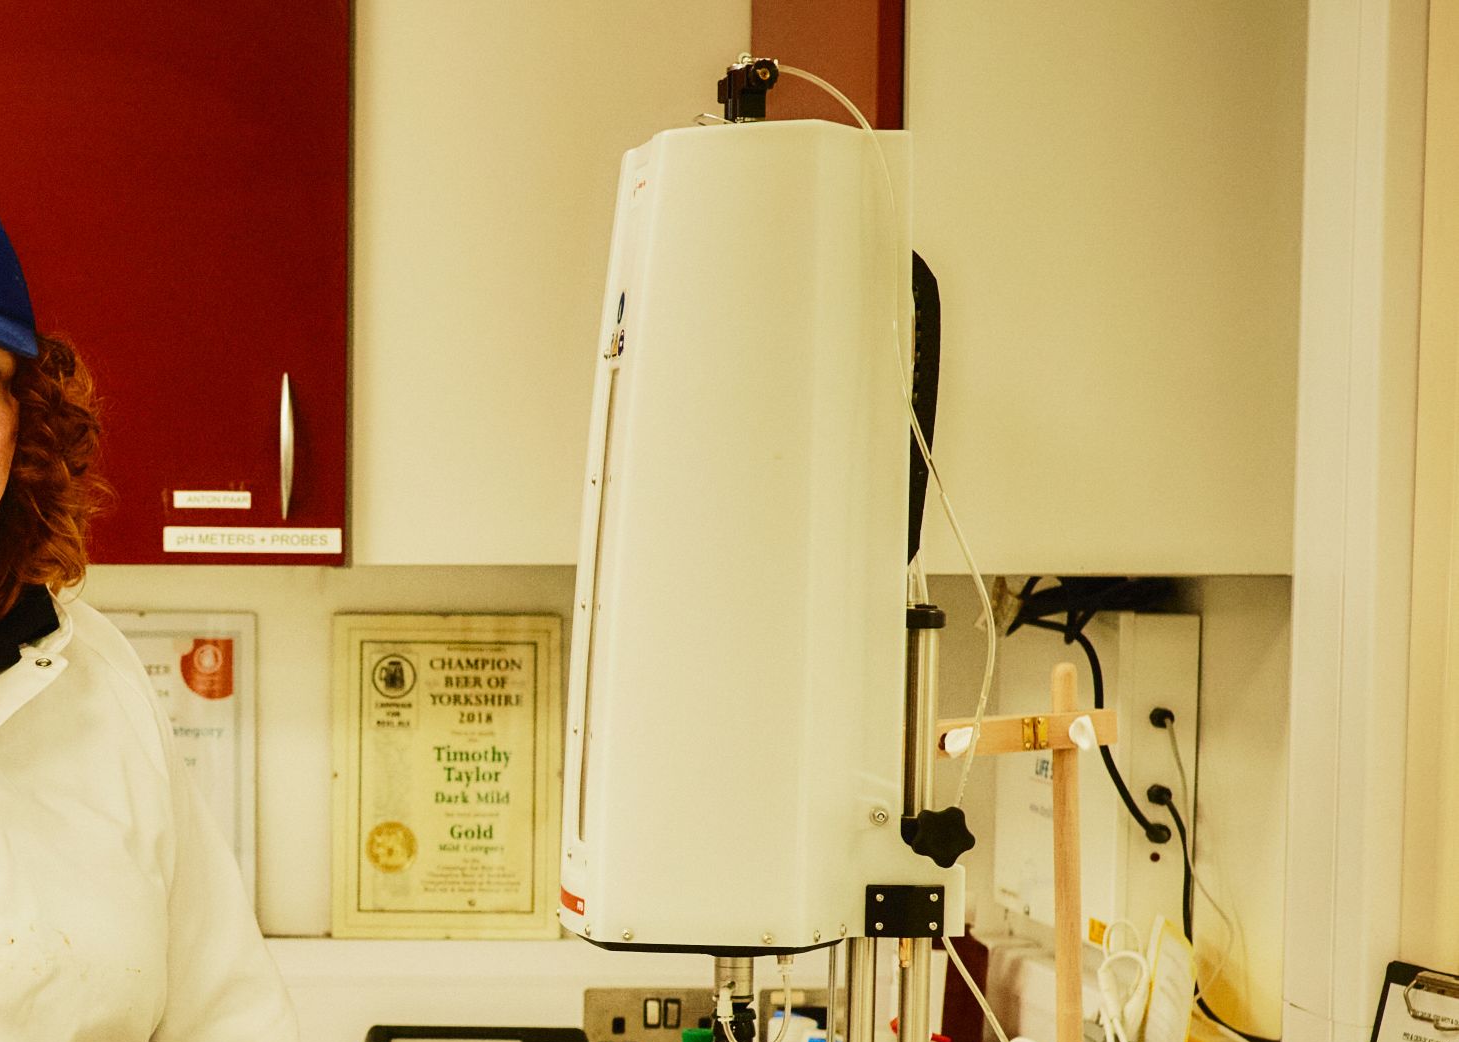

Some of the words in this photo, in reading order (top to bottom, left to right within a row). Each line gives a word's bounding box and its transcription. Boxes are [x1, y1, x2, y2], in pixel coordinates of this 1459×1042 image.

[186, 494, 221, 504] ANTON
[176, 534, 194, 547] pH
[198, 534, 256, 546] METERS
[271, 534, 329, 547] PROBES
[429, 657, 523, 671] CHAMPION
[444, 675, 483, 688] BEER
[486, 676, 509, 689] OF
[430, 693, 524, 707] YORKSHIRE
[458, 711, 494, 724] 2018
[433, 745, 512, 768] Timothy
[444, 766, 502, 788] Taylor
[434, 791, 470, 804] Dark
[476, 791, 511, 804] Mild
[449, 824, 494, 840] Gold
